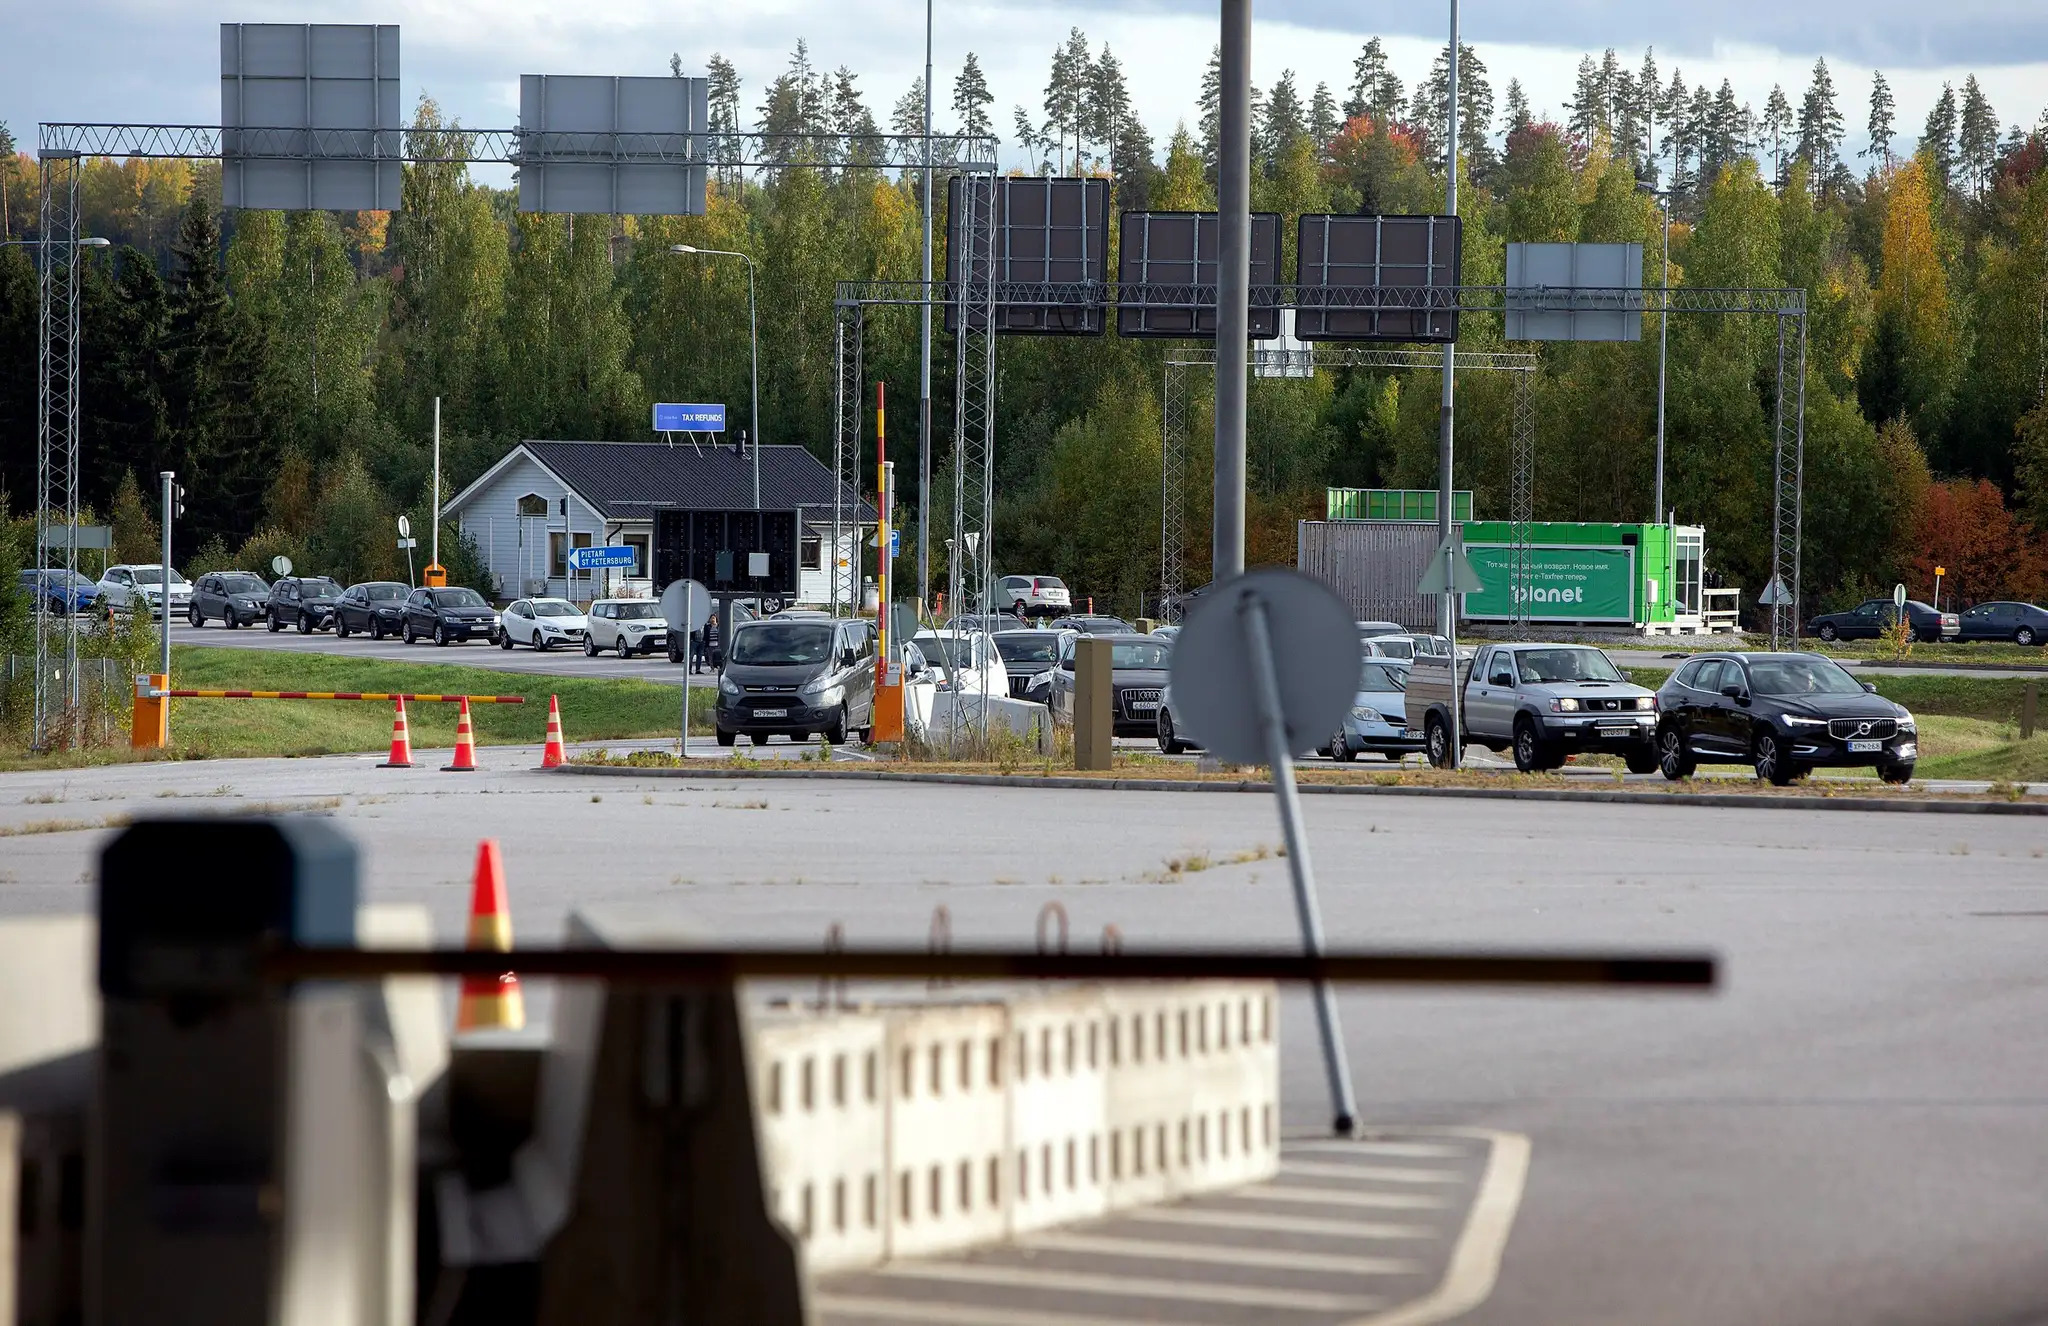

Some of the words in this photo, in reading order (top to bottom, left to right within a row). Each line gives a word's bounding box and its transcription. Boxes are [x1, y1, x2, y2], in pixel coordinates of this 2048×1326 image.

[581, 550, 605, 558] PIETARI
[591, 557, 632, 565] PETERSBURG
[1544, 563, 1572, 571] возврат.
[1534, 572, 1564, 580] e-Taxfree
[1564, 573, 1587, 581] теперь
[1513, 586, 1582, 603] planet
